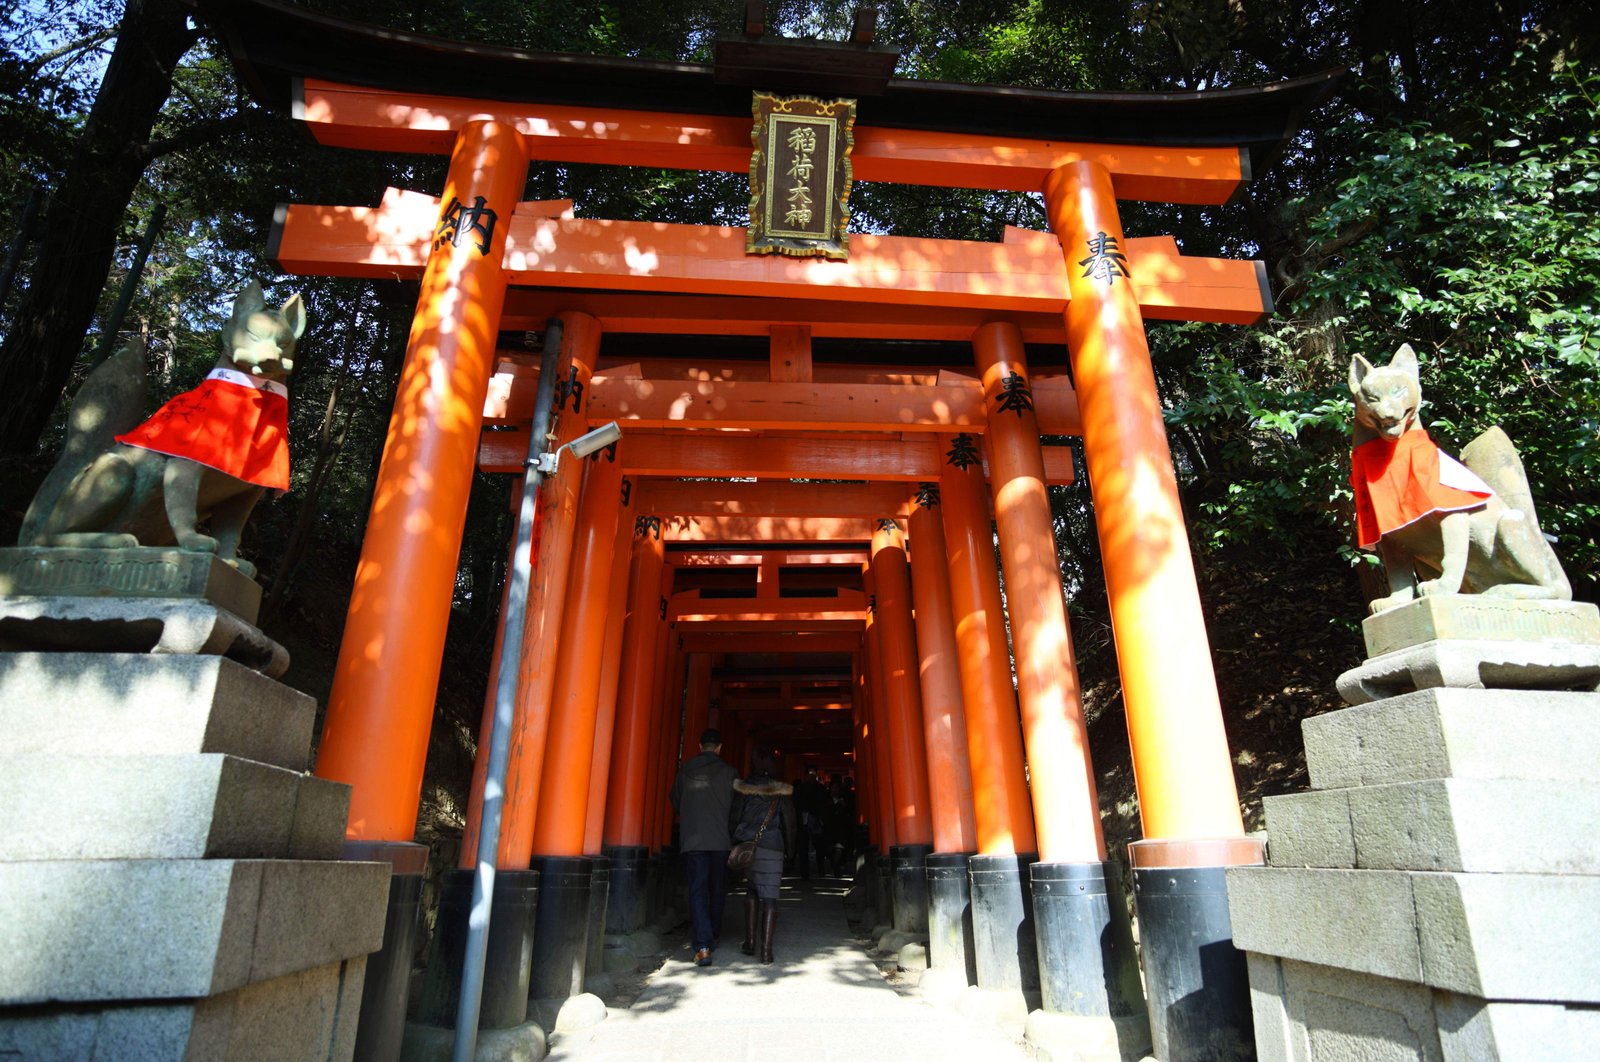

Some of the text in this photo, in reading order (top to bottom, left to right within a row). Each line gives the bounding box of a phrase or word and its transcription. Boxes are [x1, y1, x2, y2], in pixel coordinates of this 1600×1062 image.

[434, 195, 499, 257] 納
[1078, 230, 1131, 285] 奉
[995, 370, 1034, 418] 奉
[945, 432, 980, 471] 奉
